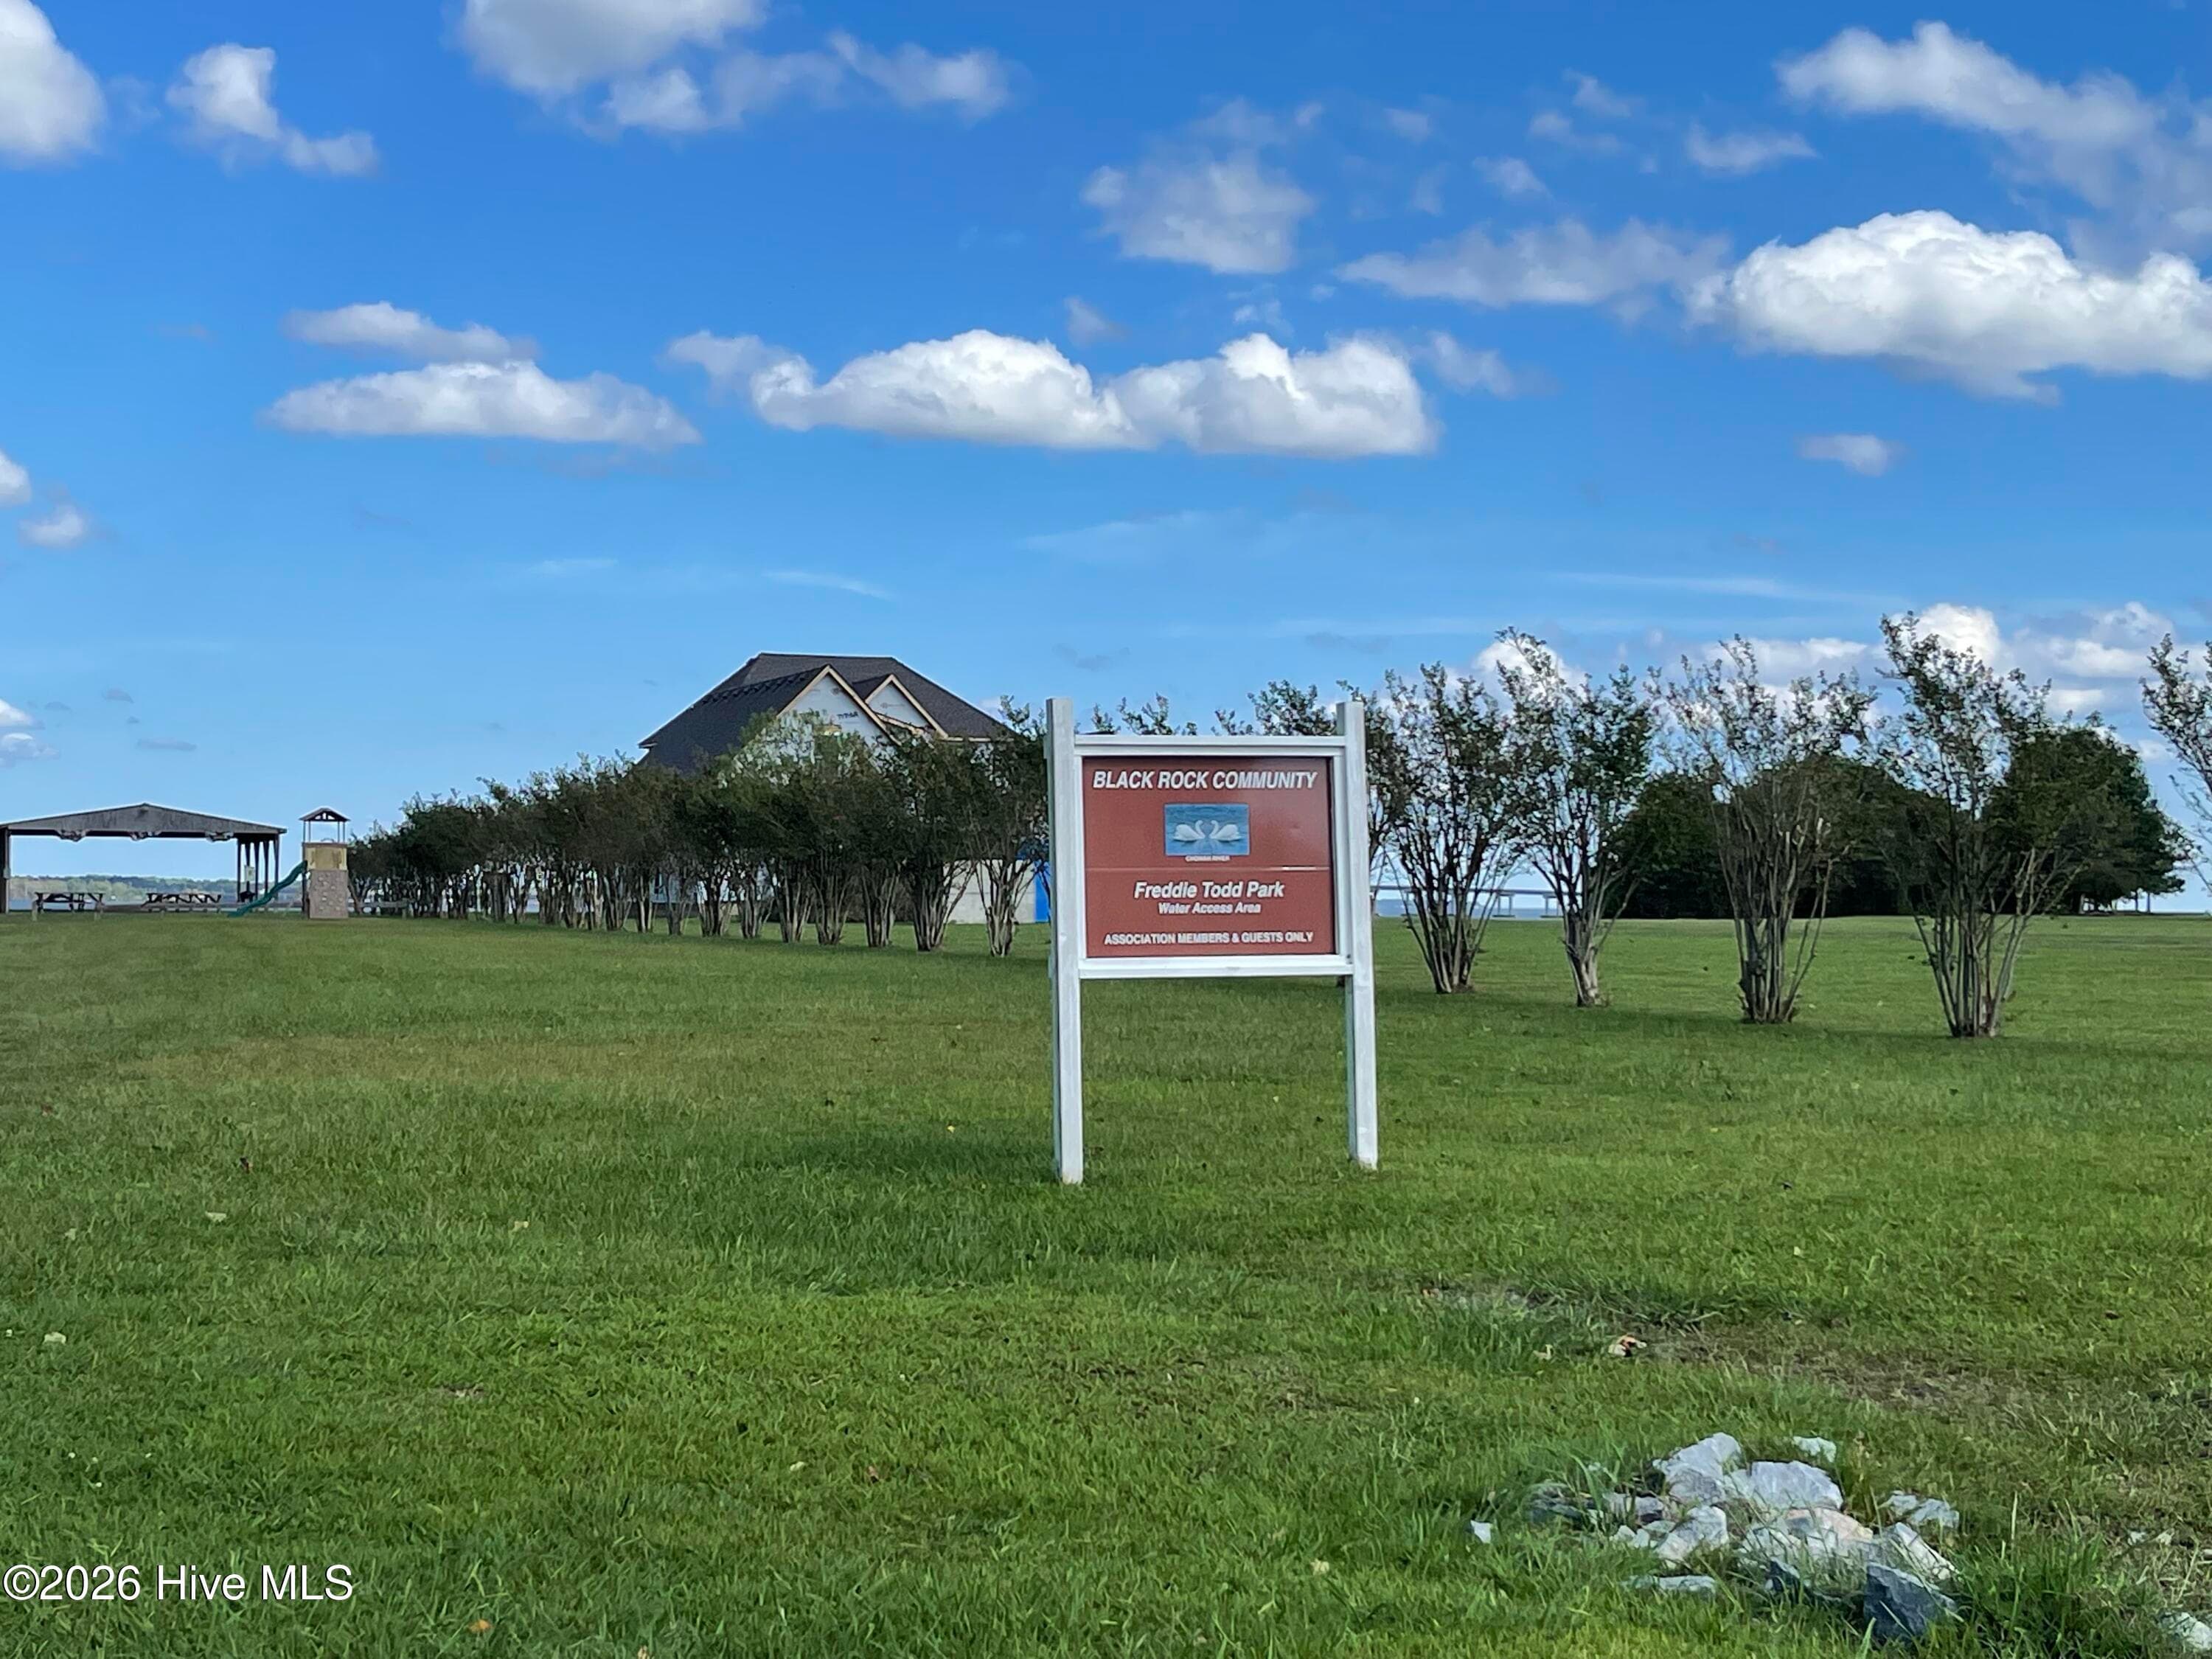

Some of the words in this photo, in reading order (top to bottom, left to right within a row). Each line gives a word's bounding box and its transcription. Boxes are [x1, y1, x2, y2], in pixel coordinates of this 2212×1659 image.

[1093, 771, 1155, 789] BLACK
[1158, 771, 1209, 789] ROCK
[1213, 771, 1318, 789] COMMUNITY
[1134, 881, 1197, 898] Freddie
[1202, 881, 1243, 898] Todd
[1246, 880, 1285, 897] Park
[1158, 902, 1191, 914] Water
[1192, 902, 1233, 914] Access
[1235, 902, 1261, 913] Area
[1104, 933, 1175, 945] ASSOCIATION
[1178, 933, 1230, 945] MEMBERS
[1231, 933, 1239, 944] &
[1242, 932, 1282, 944] GUESTS
[1285, 931, 1314, 943] ONLY
